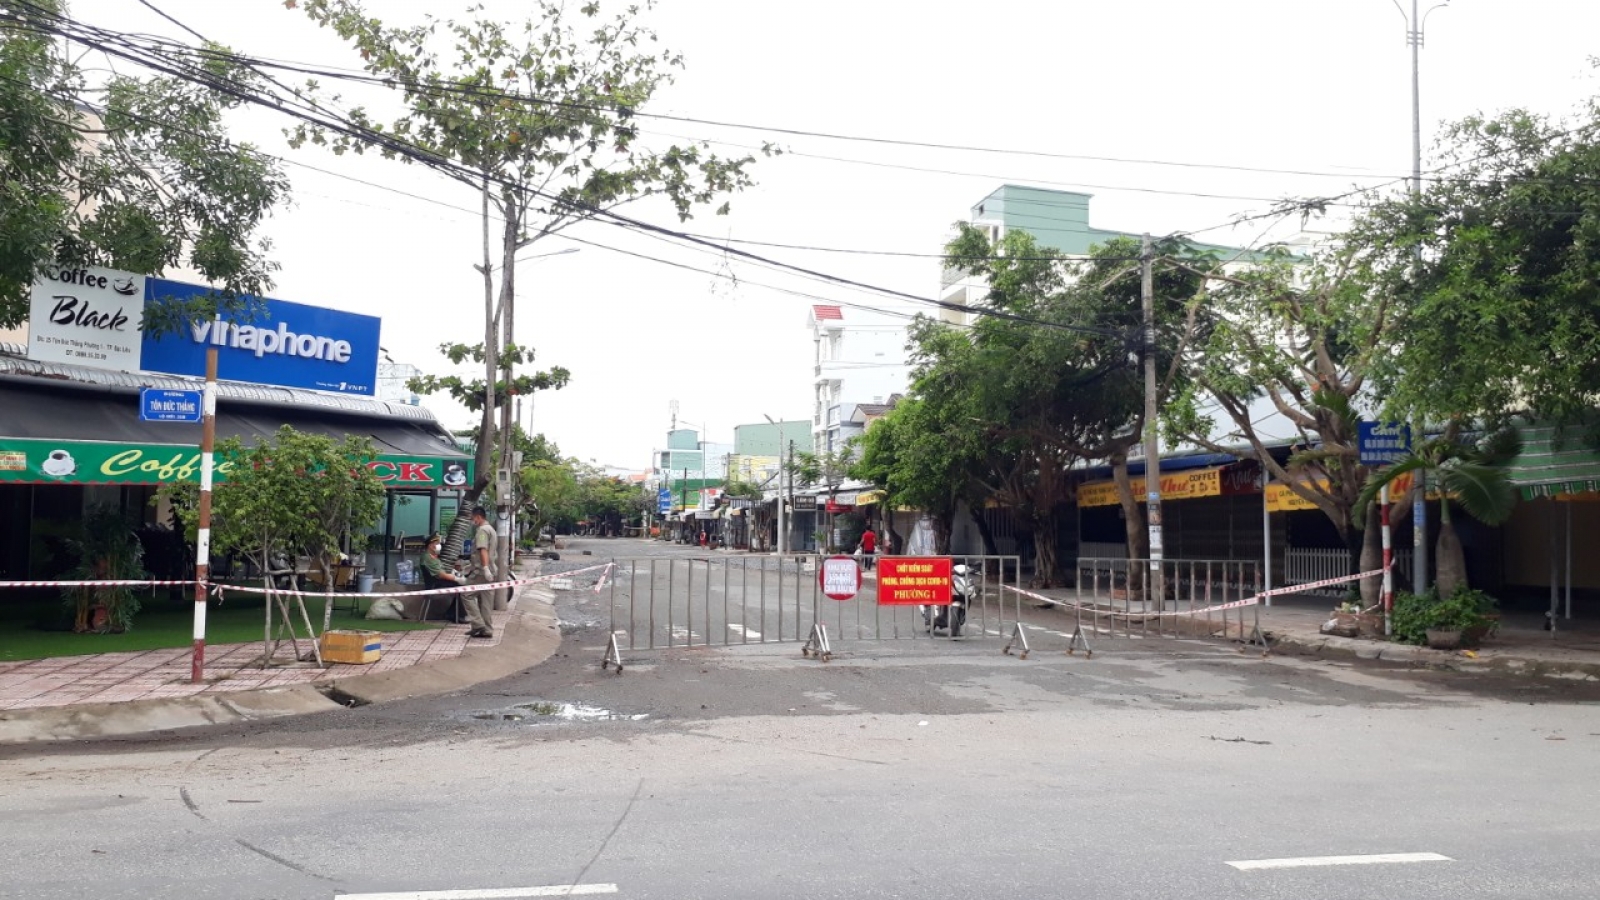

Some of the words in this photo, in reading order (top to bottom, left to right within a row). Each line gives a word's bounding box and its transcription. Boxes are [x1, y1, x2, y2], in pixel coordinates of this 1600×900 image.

[47, 264, 108, 289] Coffee
[50, 295, 128, 331] Black
[190, 313, 352, 363] vinaphone
[150, 399, 162, 411] TÔN
[163, 399, 175, 411] ĐỨC
[176, 399, 196, 412] THẮNG
[1189, 471, 1217, 482] COFFEE
[894, 588, 931, 600] PHƯỜNG
[932, 590, 936, 600] 1
